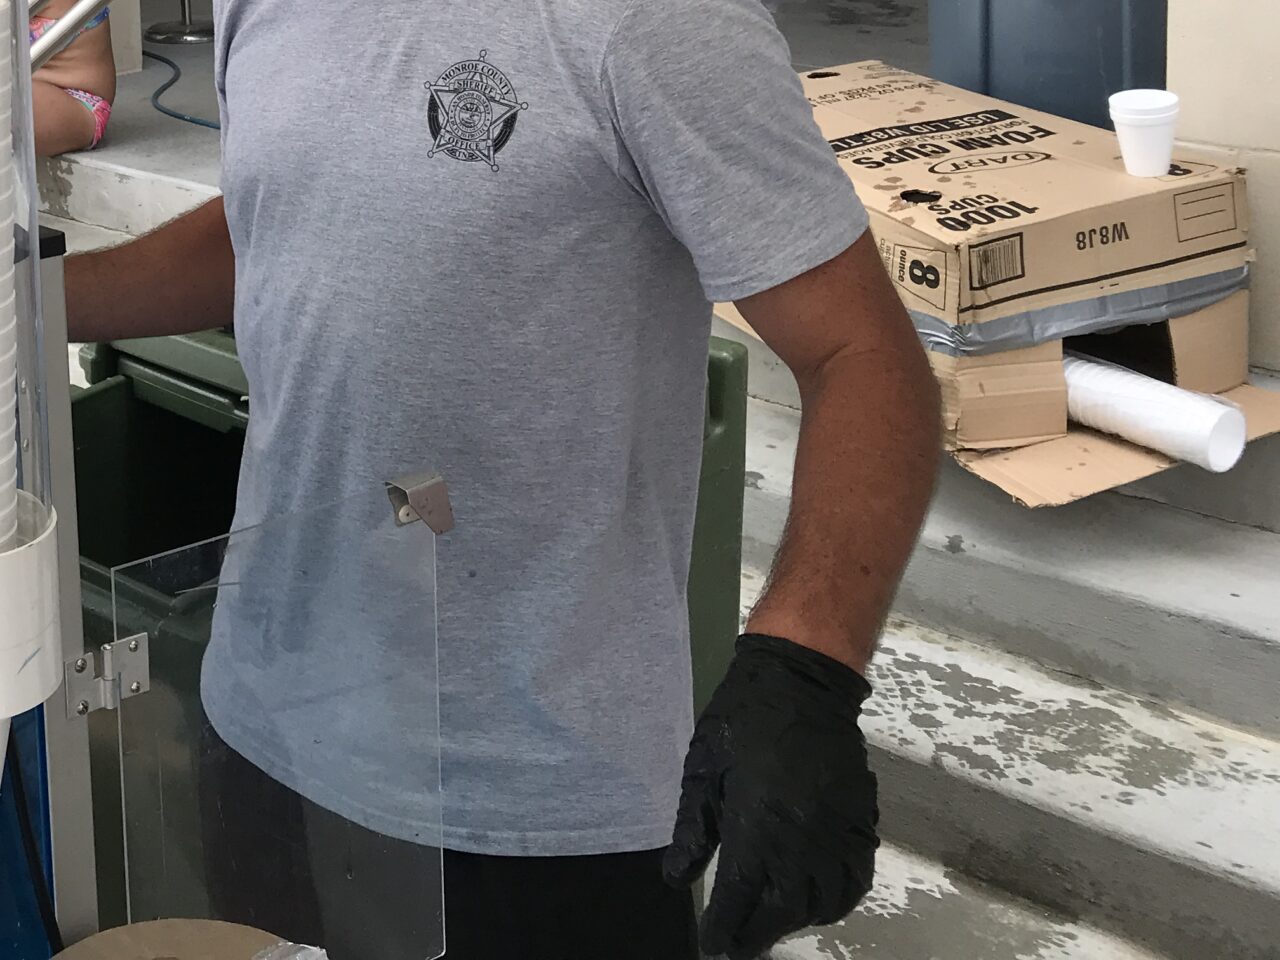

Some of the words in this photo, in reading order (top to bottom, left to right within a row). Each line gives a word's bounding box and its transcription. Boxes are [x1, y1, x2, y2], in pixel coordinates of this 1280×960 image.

[441, 63, 480, 81] MONROE
[481, 65, 512, 95] COUNTY
[457, 81, 495, 95] SHERIFF
[909, 118, 951, 133] LID
[949, 113, 1000, 128] USE
[1001, 119, 1030, 130] FOR
[448, 136, 480, 149] OFFICE
[836, 137, 916, 159] BEVERAGES
[948, 125, 1057, 151] FOAM
[852, 142, 951, 169] CUPS
[950, 152, 1036, 172] DART
[928, 194, 999, 215] CUPS
[936, 200, 1039, 232] 1000
[1076, 222, 1130, 250] W8J8
[898, 249, 907, 282] ounce
[909, 259, 940, 289] 8
